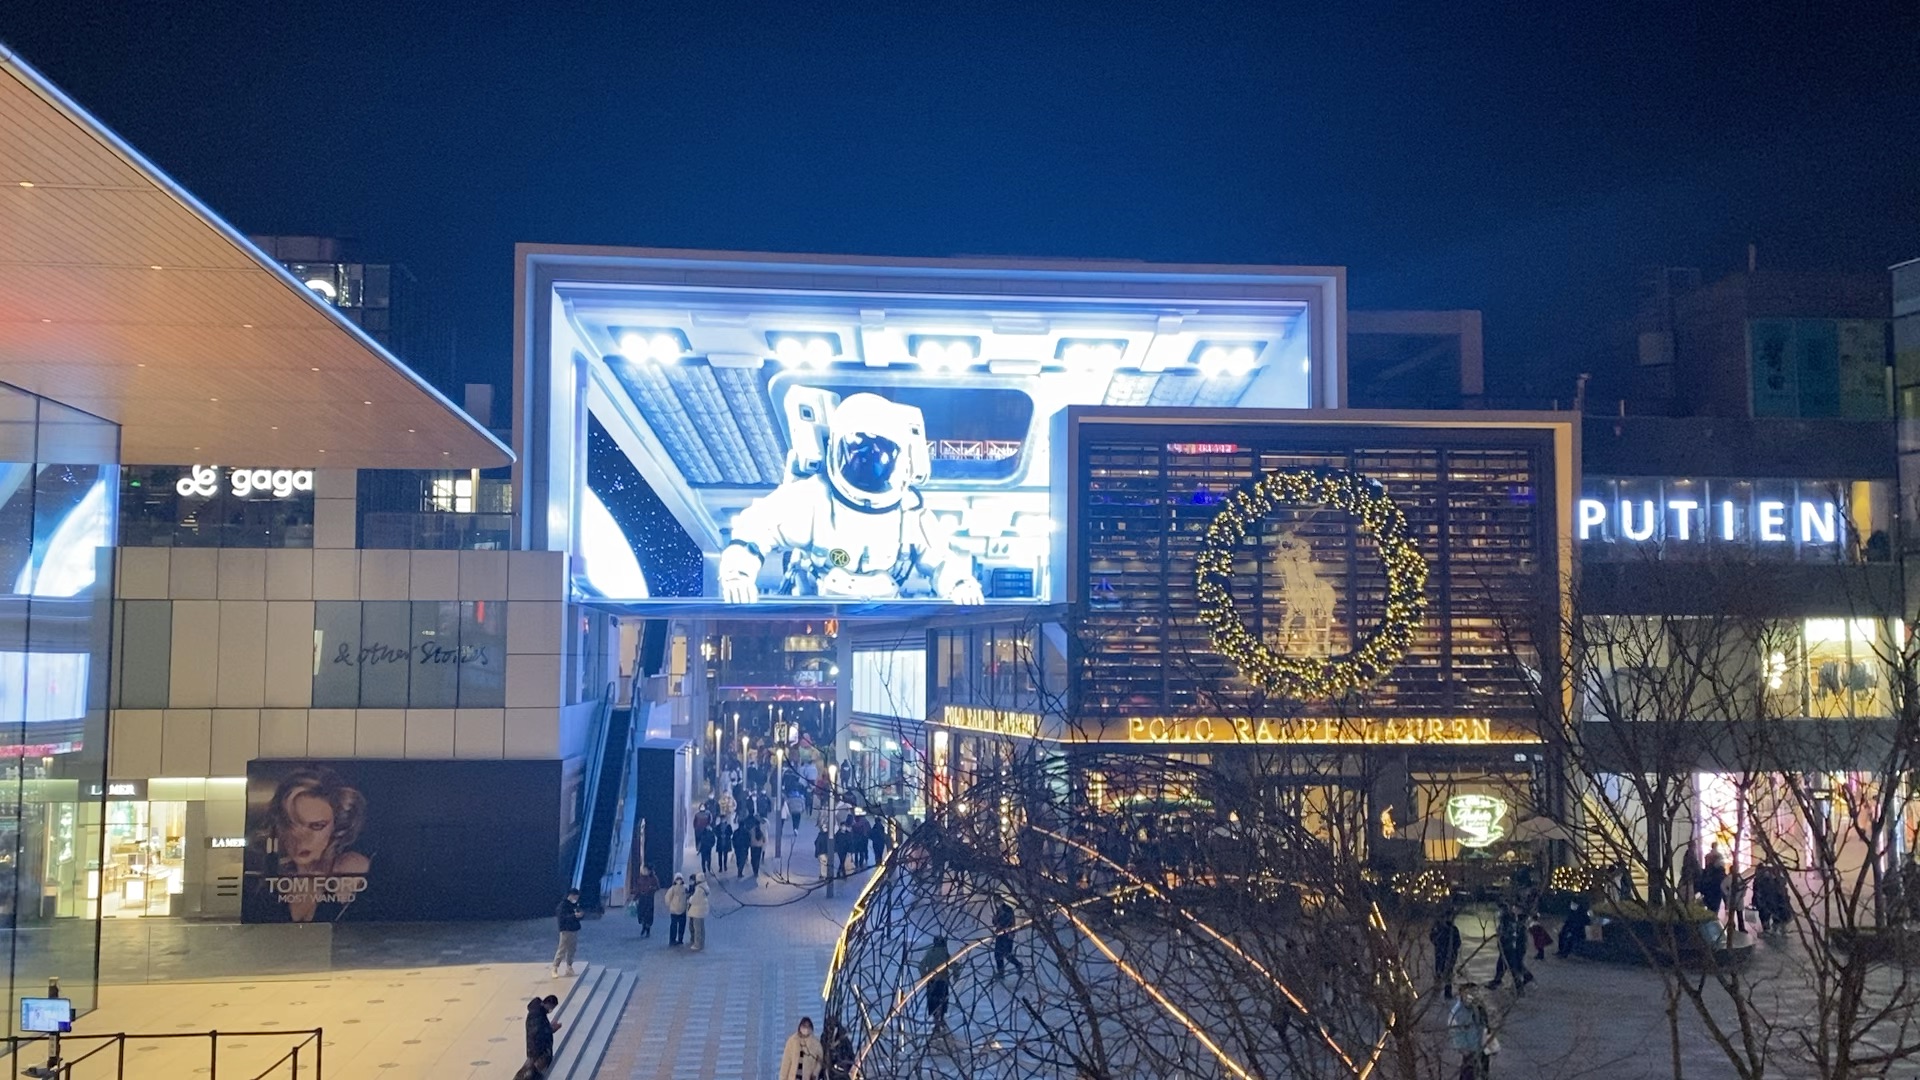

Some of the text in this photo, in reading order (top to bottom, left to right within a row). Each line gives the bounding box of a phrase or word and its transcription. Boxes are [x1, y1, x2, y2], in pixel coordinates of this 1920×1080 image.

[231, 469, 313, 497] gaga
[1579, 499, 1836, 542] PUTIEN
[334, 643, 353, 666] &
[944, 706, 965, 726] POLO
[1128, 717, 1213, 743] POLO
[1361, 718, 1491, 743] LAUREN
[108, 784, 135, 796] MER
[265, 876, 368, 893] TOM FORD
[278, 893, 356, 903] MOST WANTED
